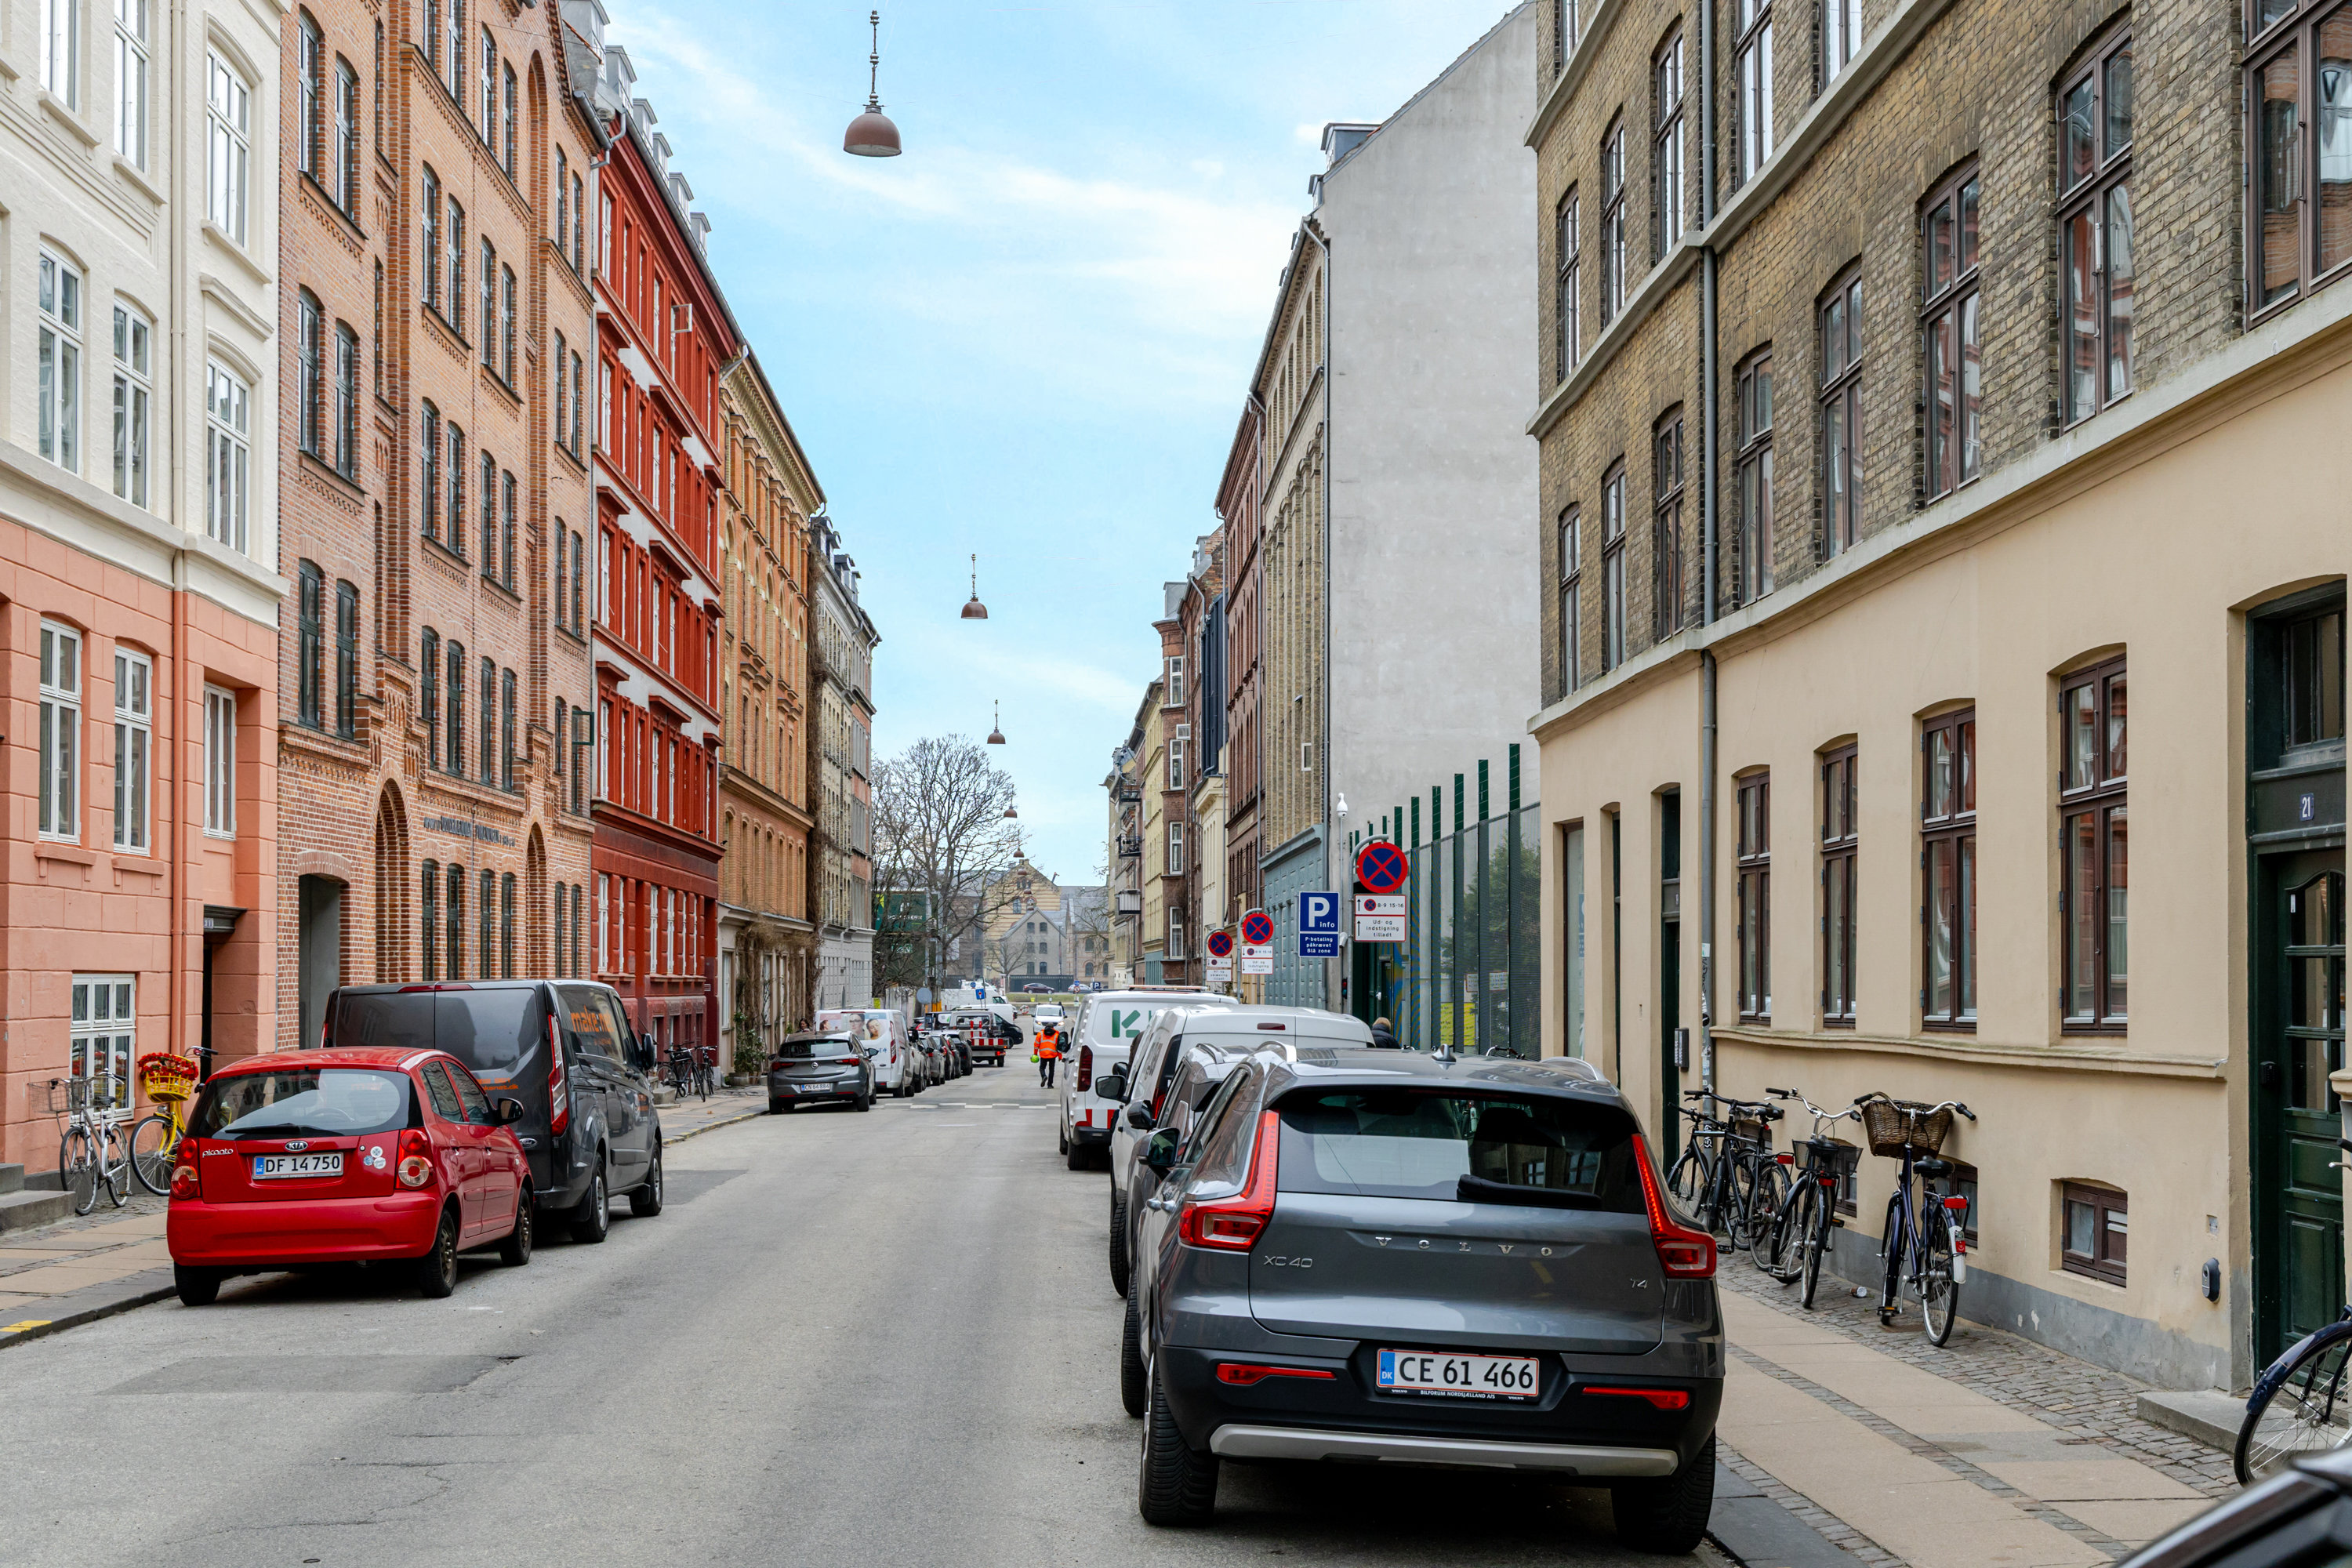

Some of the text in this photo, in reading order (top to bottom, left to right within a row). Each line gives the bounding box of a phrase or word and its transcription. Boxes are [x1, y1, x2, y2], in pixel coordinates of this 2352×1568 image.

[2302, 797, 2310, 818] 21
[1308, 896, 1330, 927] P
[202, 1149, 234, 1158] picanto
[289, 1142, 310, 1150] KIA
[265, 1156, 340, 1173] DF 14 750
[1375, 1236, 1553, 1257] VOLVO
[1630, 1278, 1648, 1290] T4
[1381, 1371, 1393, 1380] DK
[1399, 1356, 1534, 1389] CE 61 466
